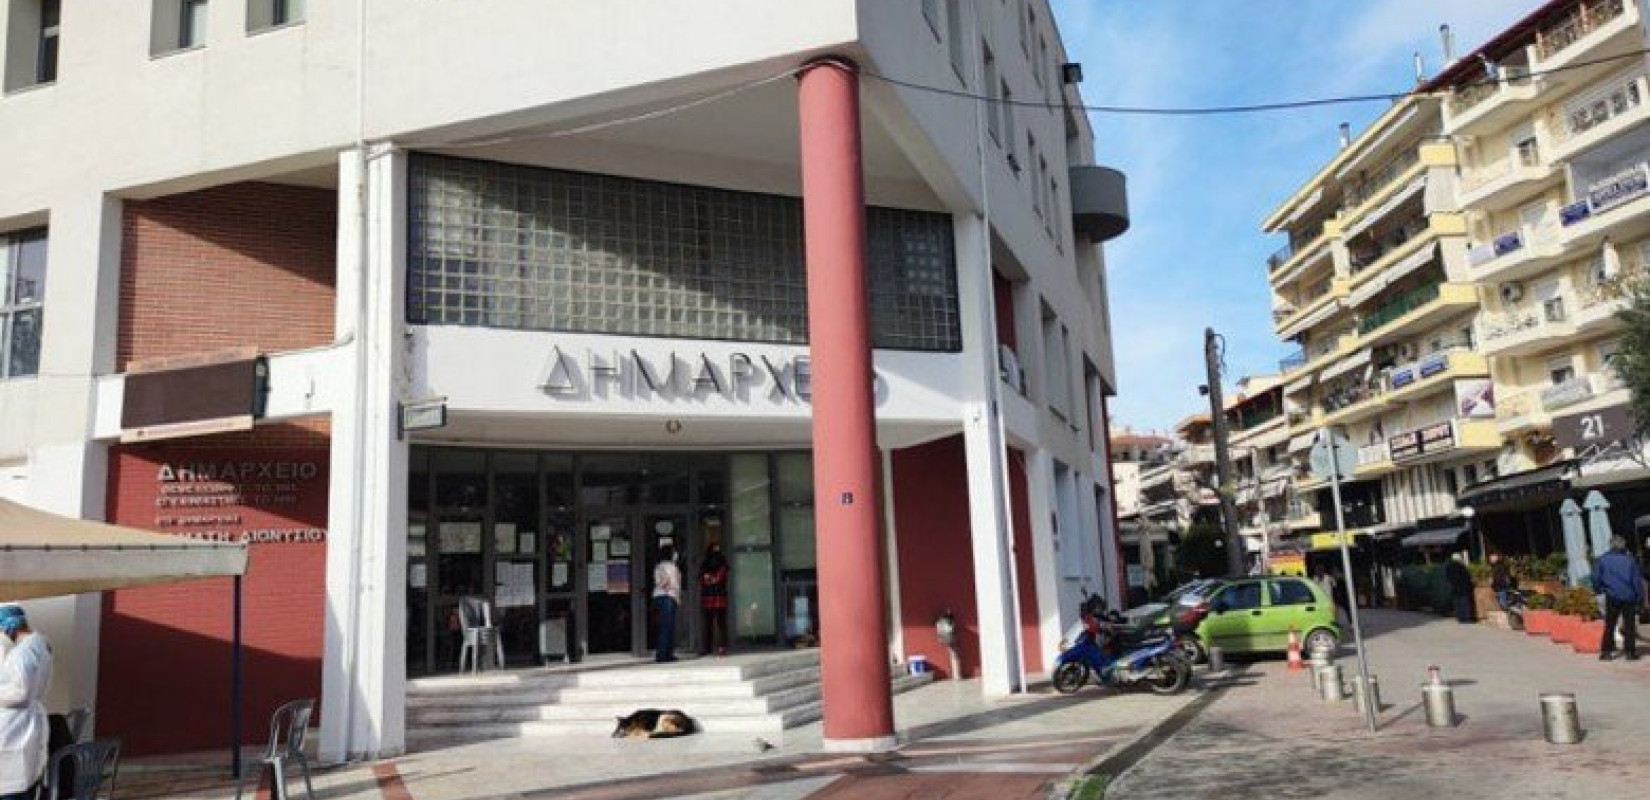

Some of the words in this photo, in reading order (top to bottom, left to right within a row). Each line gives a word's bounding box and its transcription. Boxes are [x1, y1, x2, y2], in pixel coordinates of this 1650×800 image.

[537, 344, 888, 404] ΔΗΜΑΡΧΕ
[1581, 415, 1604, 439] 21
[157, 461, 318, 481] ΔΗΜΑΡΧΕΙΟ
